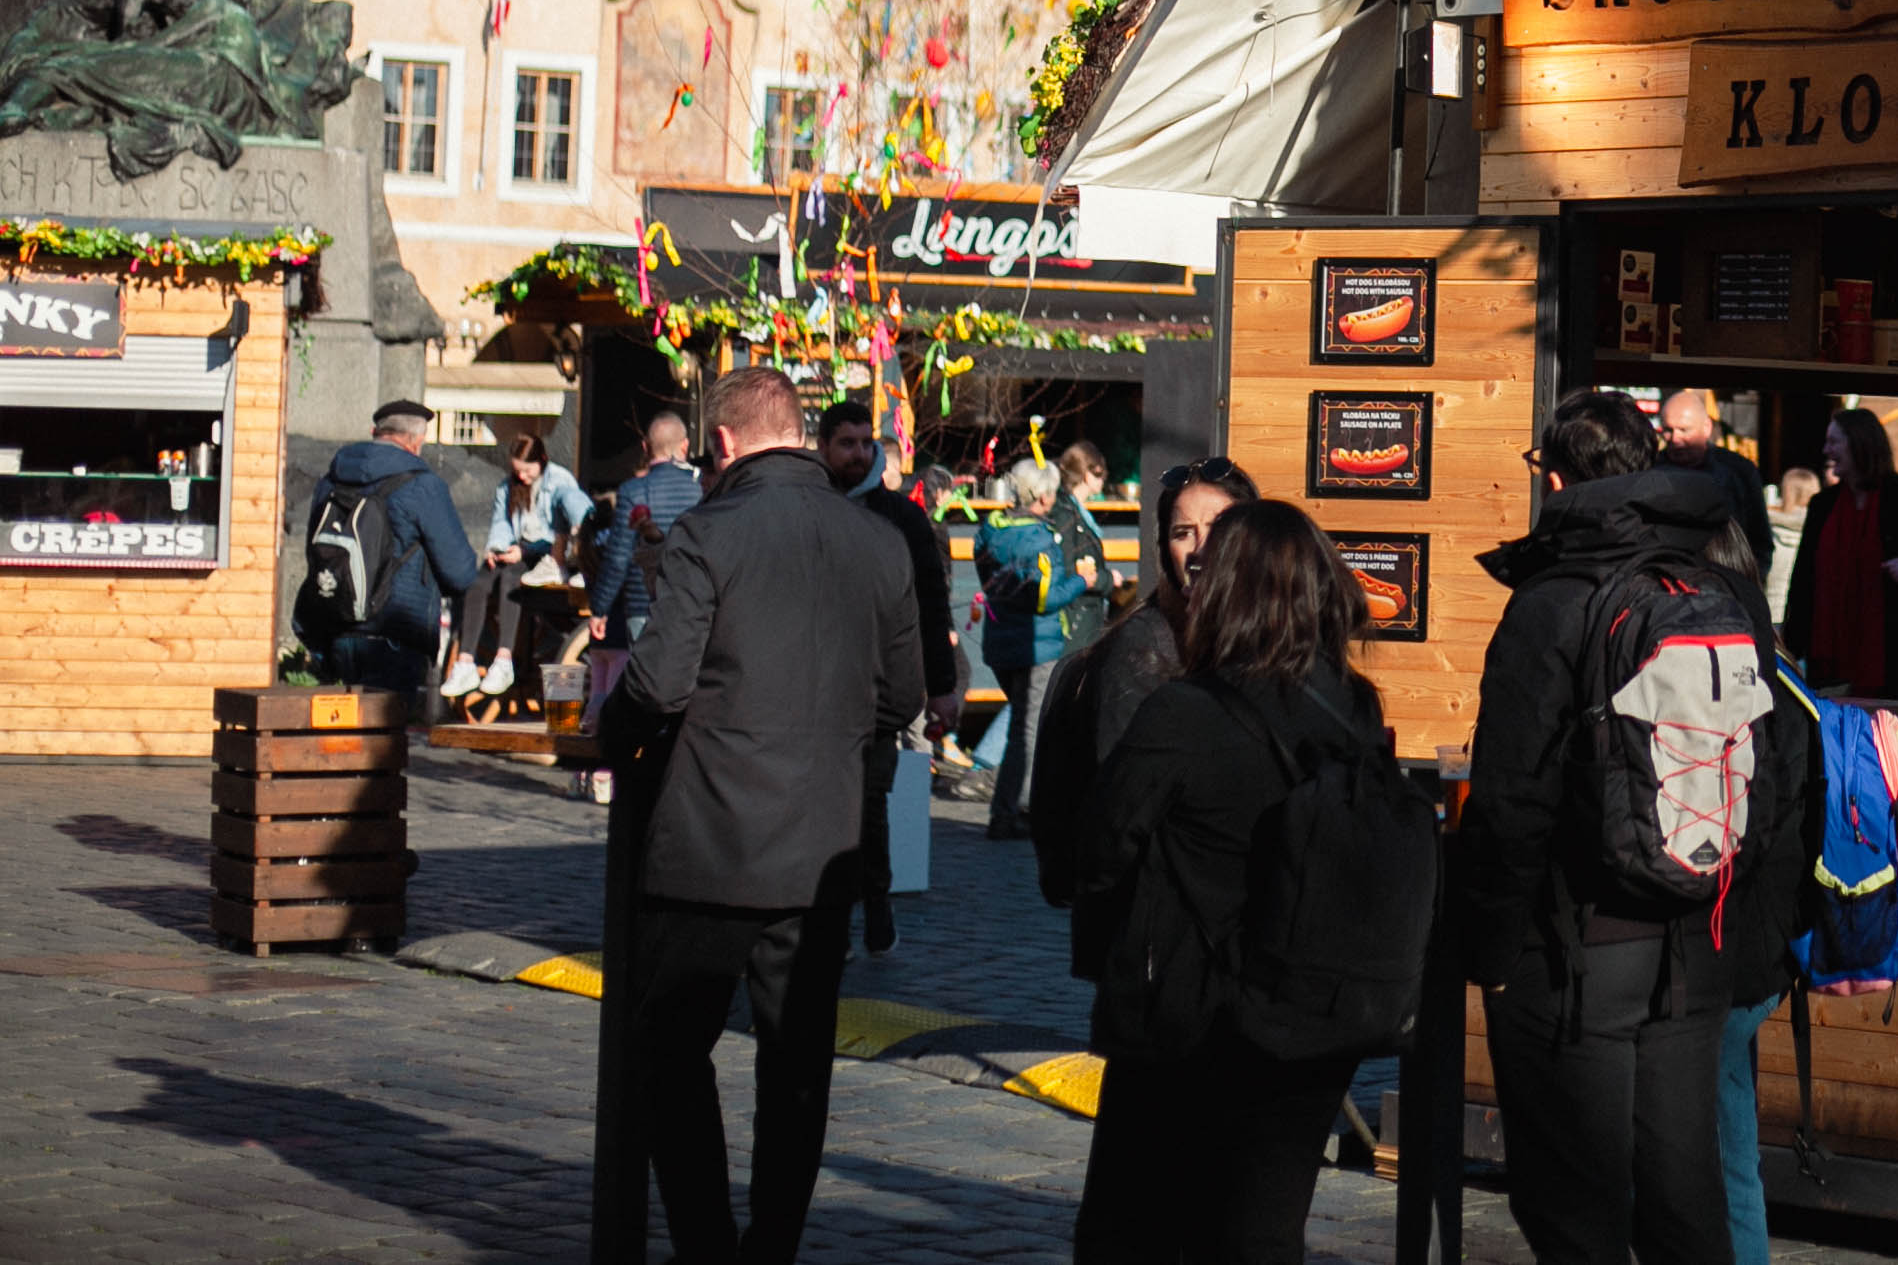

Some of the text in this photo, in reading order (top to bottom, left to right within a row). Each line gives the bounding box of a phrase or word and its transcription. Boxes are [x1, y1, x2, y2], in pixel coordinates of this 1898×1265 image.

[1345, 279, 1359, 287] HOT
[1360, 279, 1373, 287] DOG
[1342, 288, 1414, 296] HOT DOG WITH SAUSAGE
[1370, 412, 1380, 420] NA
[1340, 421, 1367, 430] SAUSAGE
[1368, 421, 1378, 430] ON
[1384, 422, 1402, 430] PLATE
[10, 523, 207, 557] CRÊPES
[1354, 553, 1369, 562] DOG
[1367, 562, 1380, 570] HOT
[1381, 563, 1395, 571] DOG
